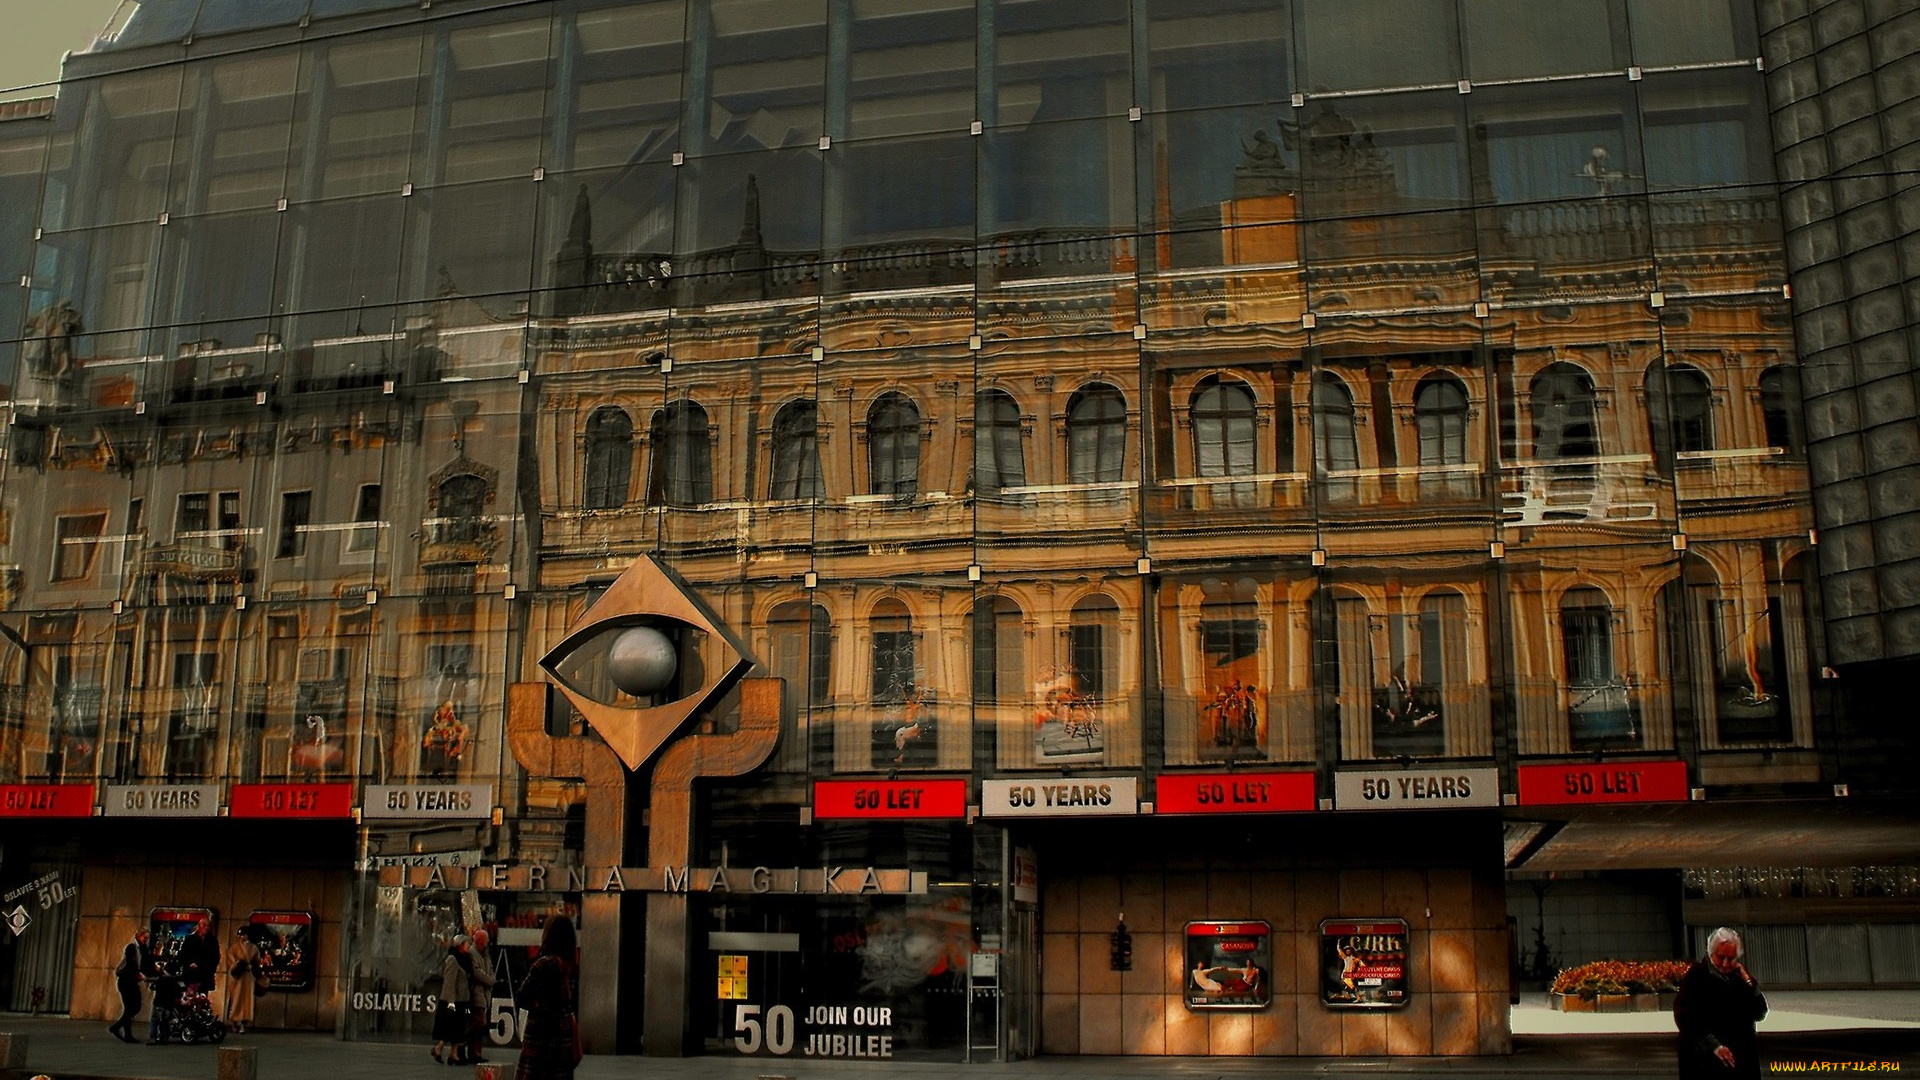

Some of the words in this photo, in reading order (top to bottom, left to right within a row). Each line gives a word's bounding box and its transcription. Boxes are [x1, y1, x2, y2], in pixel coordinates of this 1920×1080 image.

[1196, 782, 1224, 805] 50
[1231, 781, 1272, 804] LET
[1362, 778, 1390, 801] 50
[1397, 775, 1471, 800] YEARS
[1566, 772, 1594, 795] 50
[1602, 771, 1644, 794] LET
[6, 790, 25, 809] 50
[124, 791, 144, 809] 50
[150, 790, 200, 809] YEARS
[262, 790, 284, 810] 50
[386, 791, 409, 810] 50
[415, 791, 471, 810] YEARS
[853, 789, 880, 810] 50
[887, 788, 923, 809] LET
[1009, 786, 1035, 807] 50
[1042, 785, 1112, 807] YEARS
[400, 864, 626, 892] LATERNA
[663, 865, 883, 893] MAGIKA
[4, 882, 33, 903] OSLAVTE
[38, 882, 64, 910] 50
[64, 886, 77, 899] LET
[353, 992, 421, 1013] OSLAVTE
[426, 994, 436, 1013] S
[804, 1006, 848, 1026] JOIN
[853, 1006, 892, 1027] OUR
[734, 1004, 795, 1055] 50
[804, 1033, 893, 1058] JUBILEE
